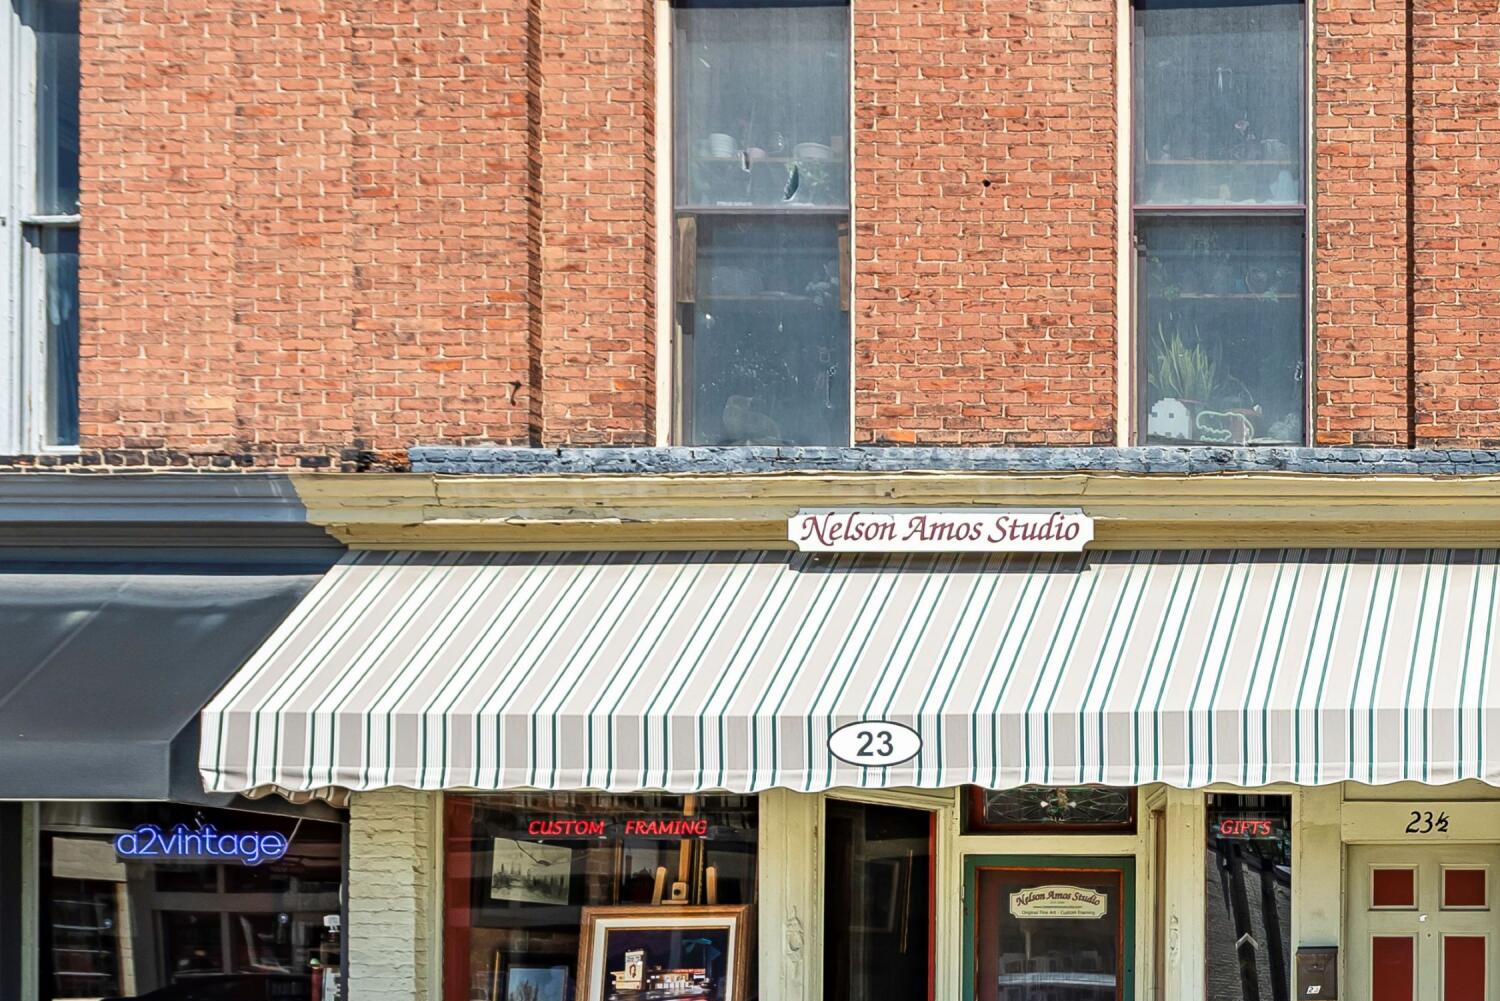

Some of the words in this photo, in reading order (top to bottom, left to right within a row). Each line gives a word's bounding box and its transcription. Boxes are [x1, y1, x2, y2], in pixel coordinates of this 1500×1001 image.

[800, 511, 896, 546] Nelson
[902, 514, 983, 541] Amos
[987, 511, 1080, 544] Studio
[856, 731, 894, 756] 23
[528, 819, 606, 835] CUSTOM
[625, 819, 708, 835] FRAMING
[1220, 819, 1272, 836] GIFTS
[116, 827, 285, 862] a2vintage
[1016, 892, 1045, 907] Nelson
[1046, 890, 1072, 900] Amos
[1072, 891, 1101, 906] Studio
